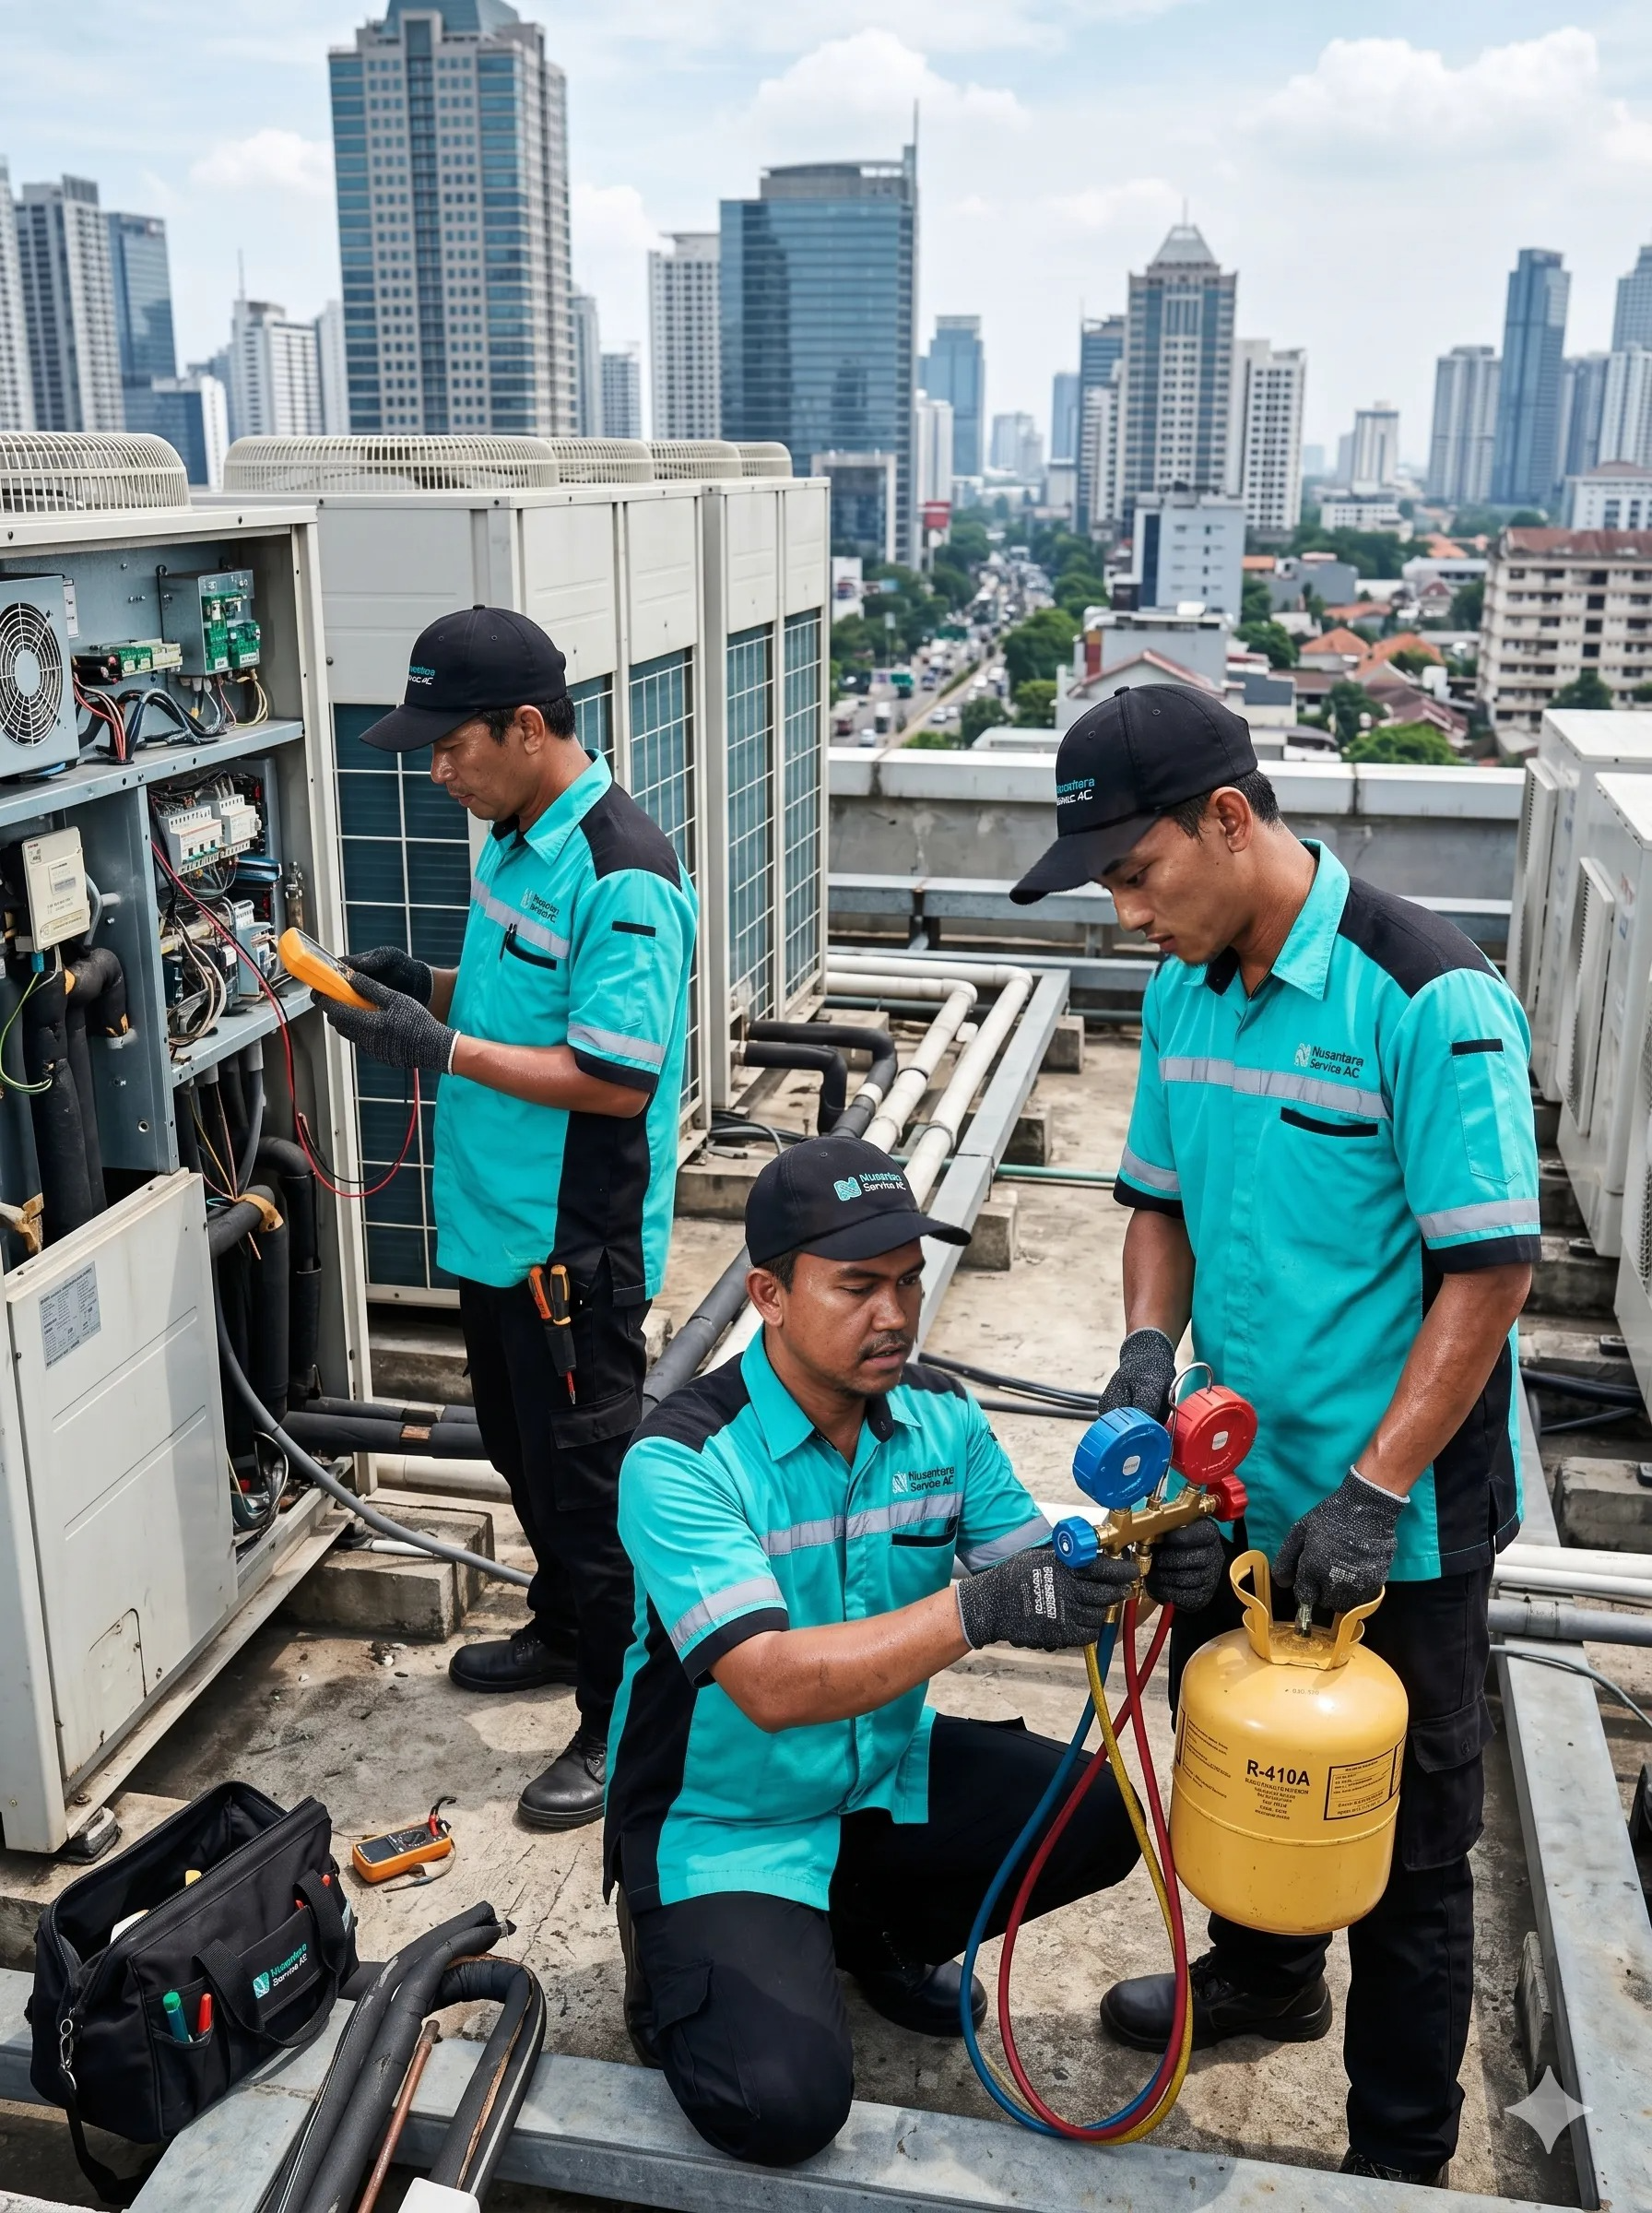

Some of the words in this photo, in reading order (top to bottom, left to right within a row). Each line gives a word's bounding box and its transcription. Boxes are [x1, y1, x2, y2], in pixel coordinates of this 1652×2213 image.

[1077, 788, 1093, 801] AC
[1312, 1046, 1364, 1067] Nusantara
[1342, 1065, 1361, 1079] AC
[942, 1474, 954, 1486] AC
[1246, 1758, 1311, 1787] R-410A
